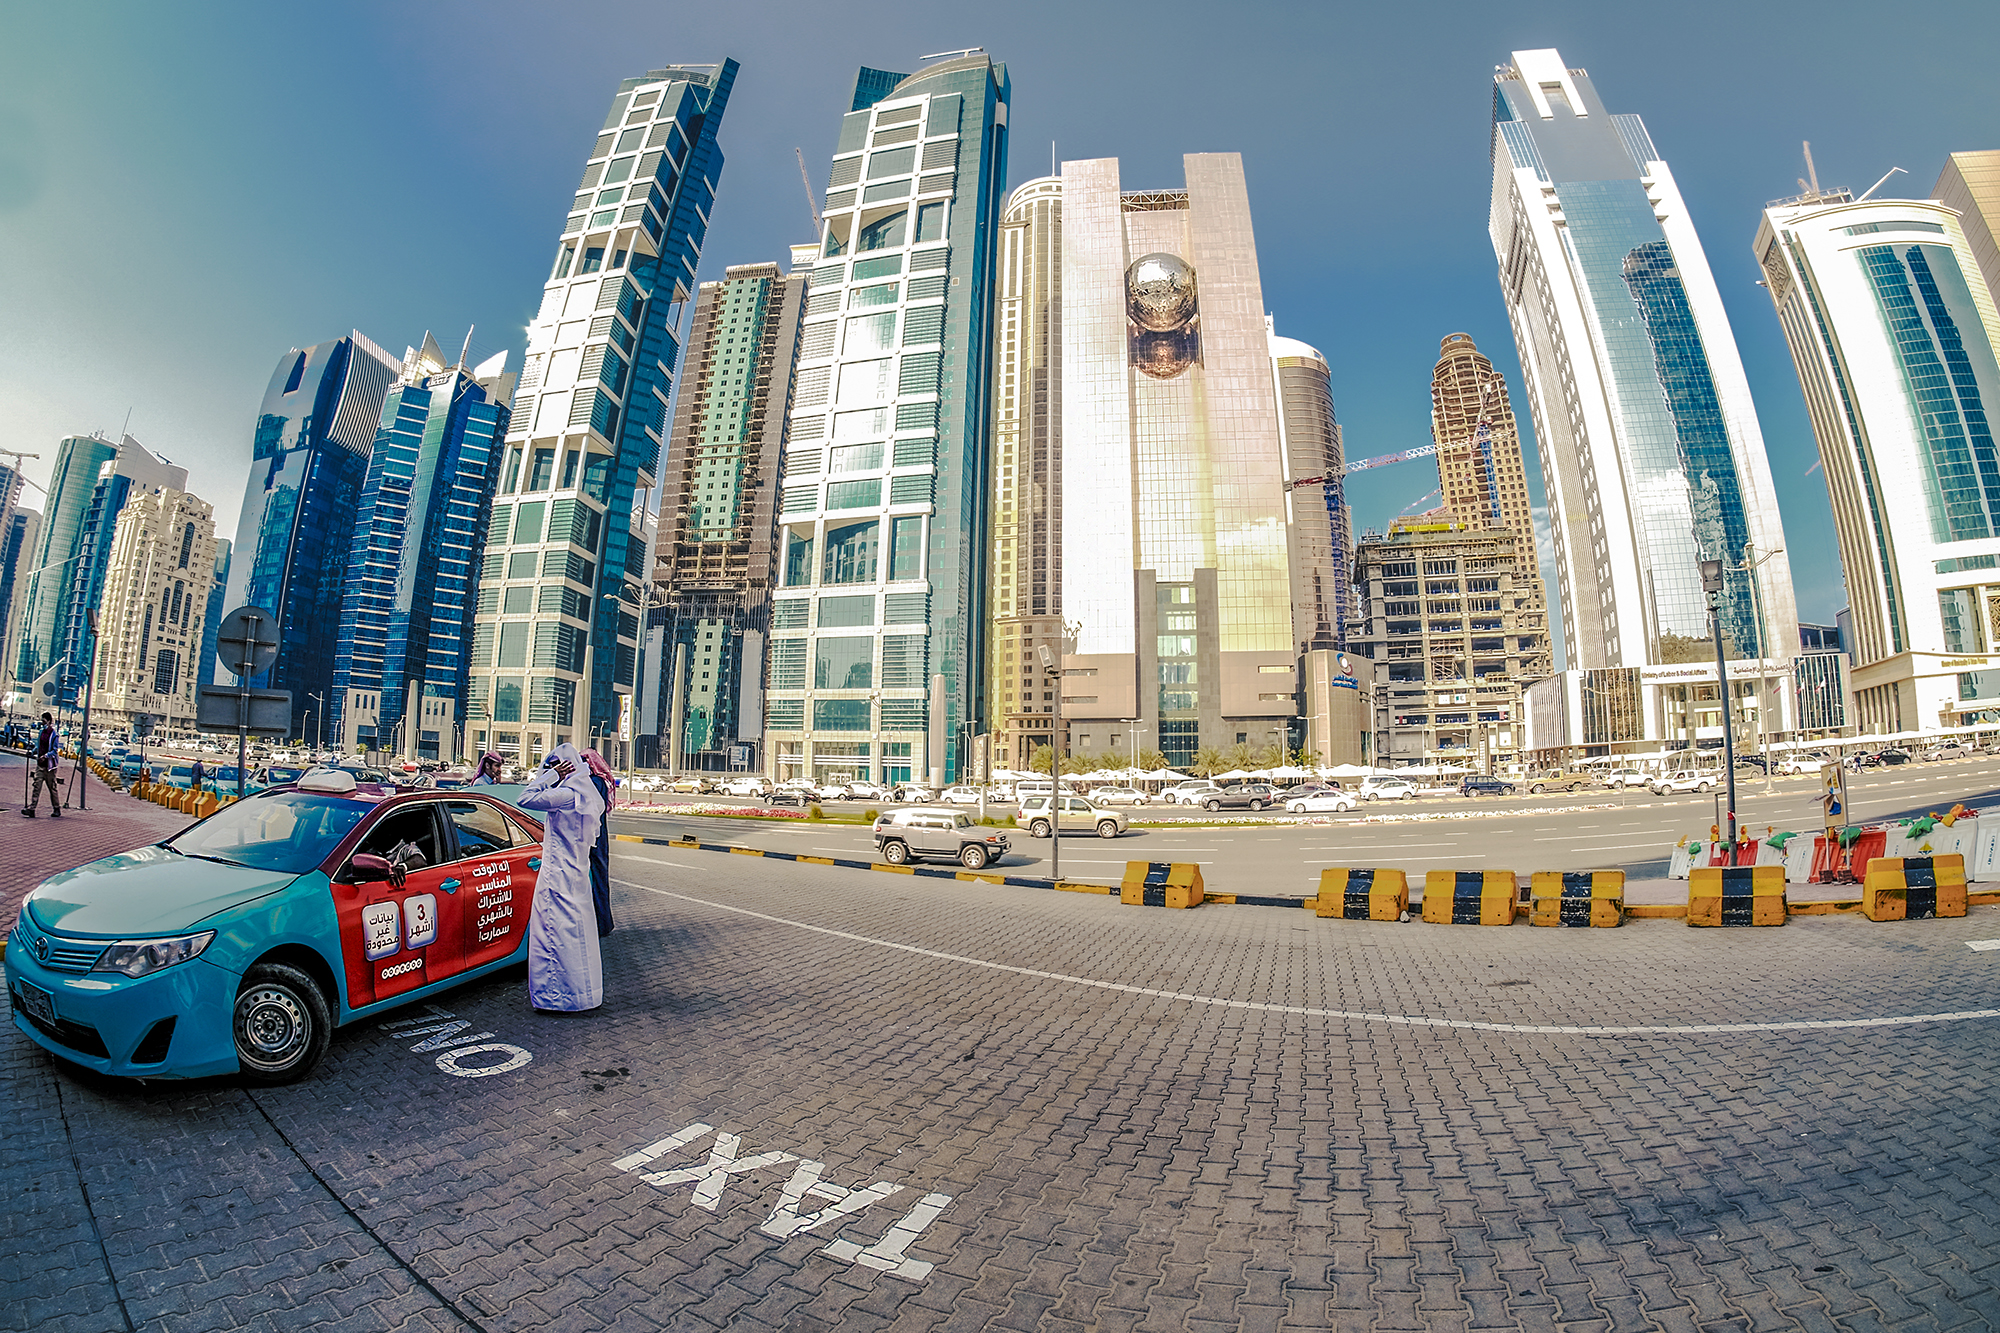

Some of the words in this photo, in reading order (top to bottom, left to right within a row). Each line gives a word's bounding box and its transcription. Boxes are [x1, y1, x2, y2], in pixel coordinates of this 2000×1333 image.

[472, 862, 498, 877] الوقت
[475, 874, 512, 895] المناسب
[477, 890, 513, 909] للاشتراك
[369, 912, 394, 926] بيانات
[417, 904, 425, 920] 3
[477, 905, 513, 929] بالشهري
[375, 924, 390, 939] غير
[408, 916, 434, 939] أشهر
[478, 925, 510, 942] سمارت!
[366, 935, 400, 950] محدودة
[381, 957, 423, 980] ooredoo
[378, 1004, 534, 1078] ONL
[611, 1123, 952, 1280] TAXI
